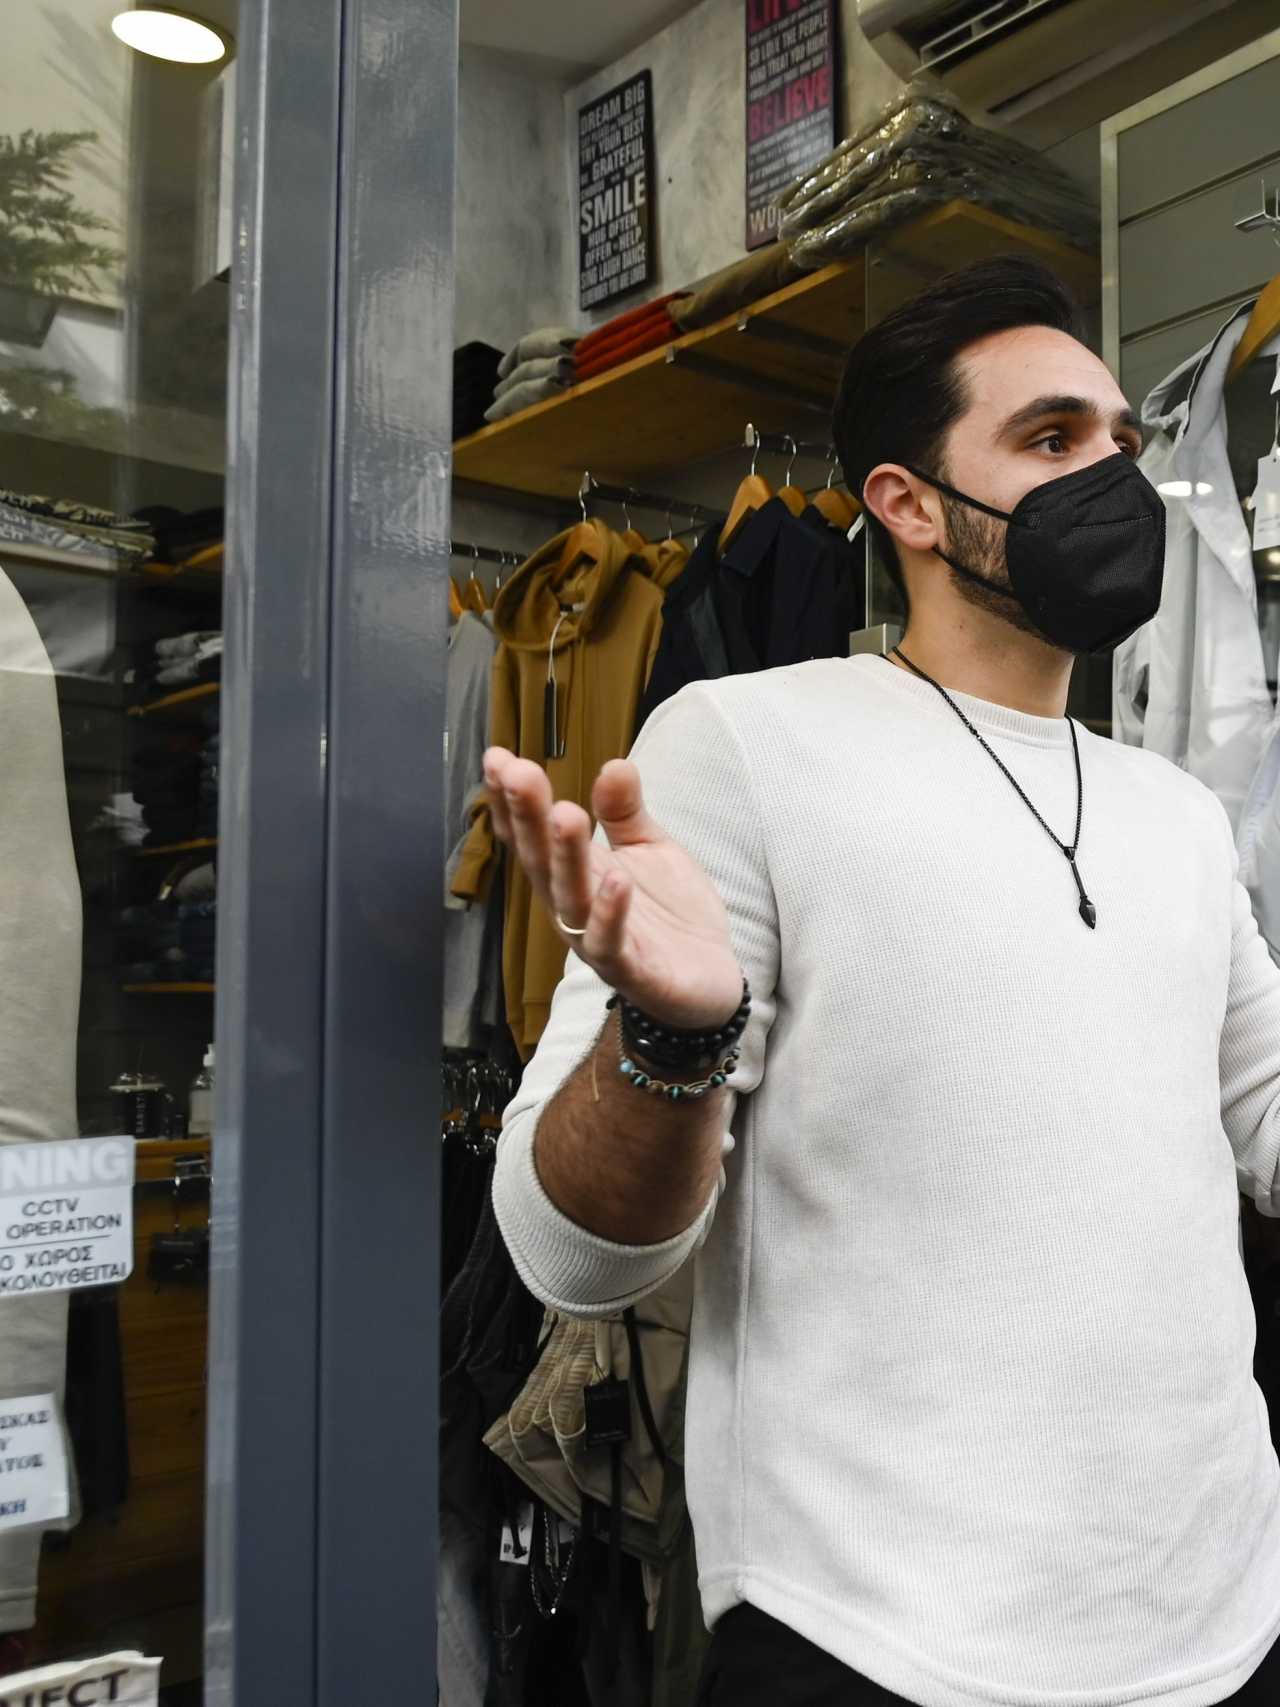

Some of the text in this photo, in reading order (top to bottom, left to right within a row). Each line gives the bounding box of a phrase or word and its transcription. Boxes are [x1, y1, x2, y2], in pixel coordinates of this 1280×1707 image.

[580, 94, 620, 135] DREAM
[624, 79, 645, 109] BIG
[750, 64, 830, 141] BELIEVE
[592, 136, 644, 181] GRATEFUL
[580, 171, 646, 235] SMILE
[608, 209, 638, 238] OFTEN
[585, 225, 642, 267] OFFER HELP
[1, 1141, 129, 1189] NING
[6, 1213, 122, 1240] OPERATION
[22, 1197, 80, 1217] CCTV
[25, 1244, 94, 1268] ΧΩΡΟΣ
